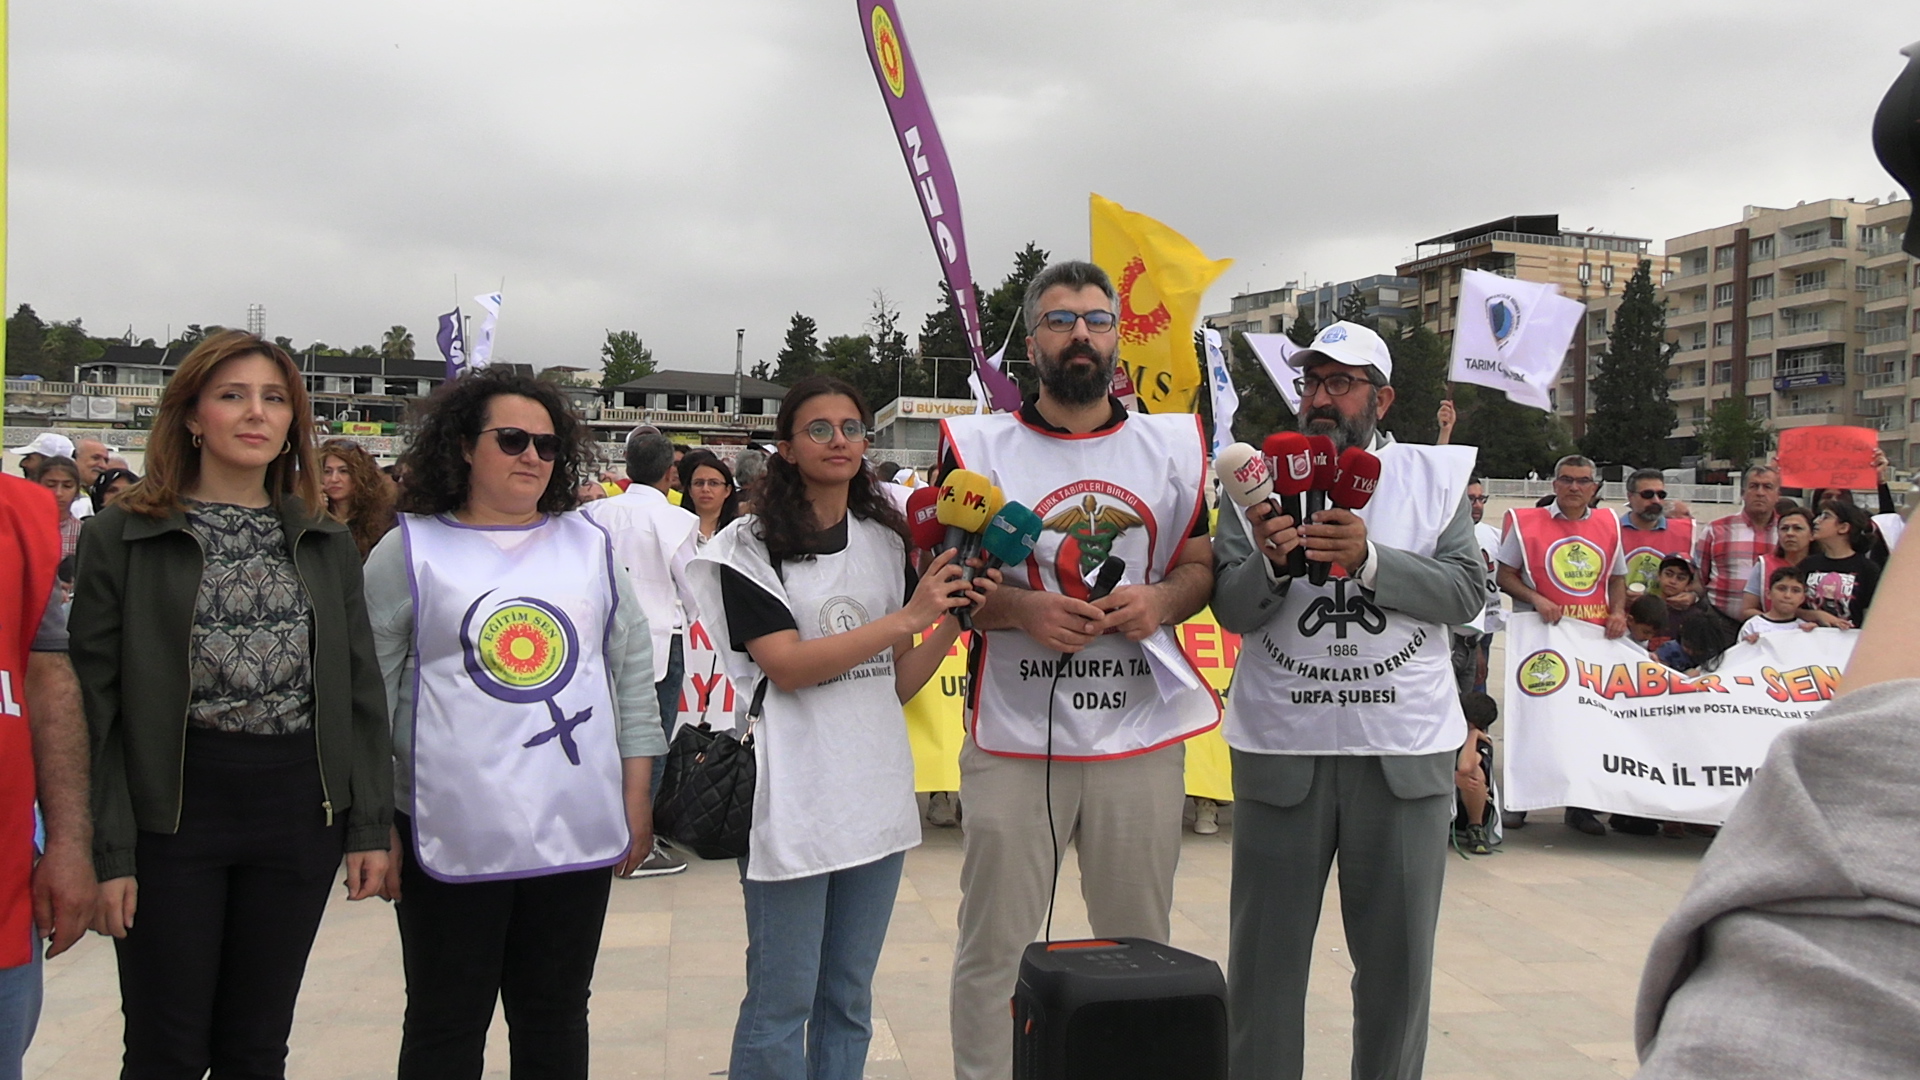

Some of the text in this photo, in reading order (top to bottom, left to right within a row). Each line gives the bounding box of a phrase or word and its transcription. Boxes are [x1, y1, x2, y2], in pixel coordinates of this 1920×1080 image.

[1465, 358, 1496, 372] TARIM
[484, 611, 558, 642] EĞİTİM SEN
[1262, 626, 1427, 682] İNSAN HAKLARI DERNEĞİ
[1327, 644, 1358, 657] 1986
[1072, 690, 1127, 710] ODASI
[1291, 686, 1396, 706] URFA ŞUBESİ
[1640, 704, 1686, 718] İLETİŞİM
[1689, 706, 1701, 714] ve
[1704, 704, 1739, 714] POSTA
[1742, 706, 1802, 719] EMEKÇİLERİ
[1602, 753, 1761, 787] URFA İL TEM
